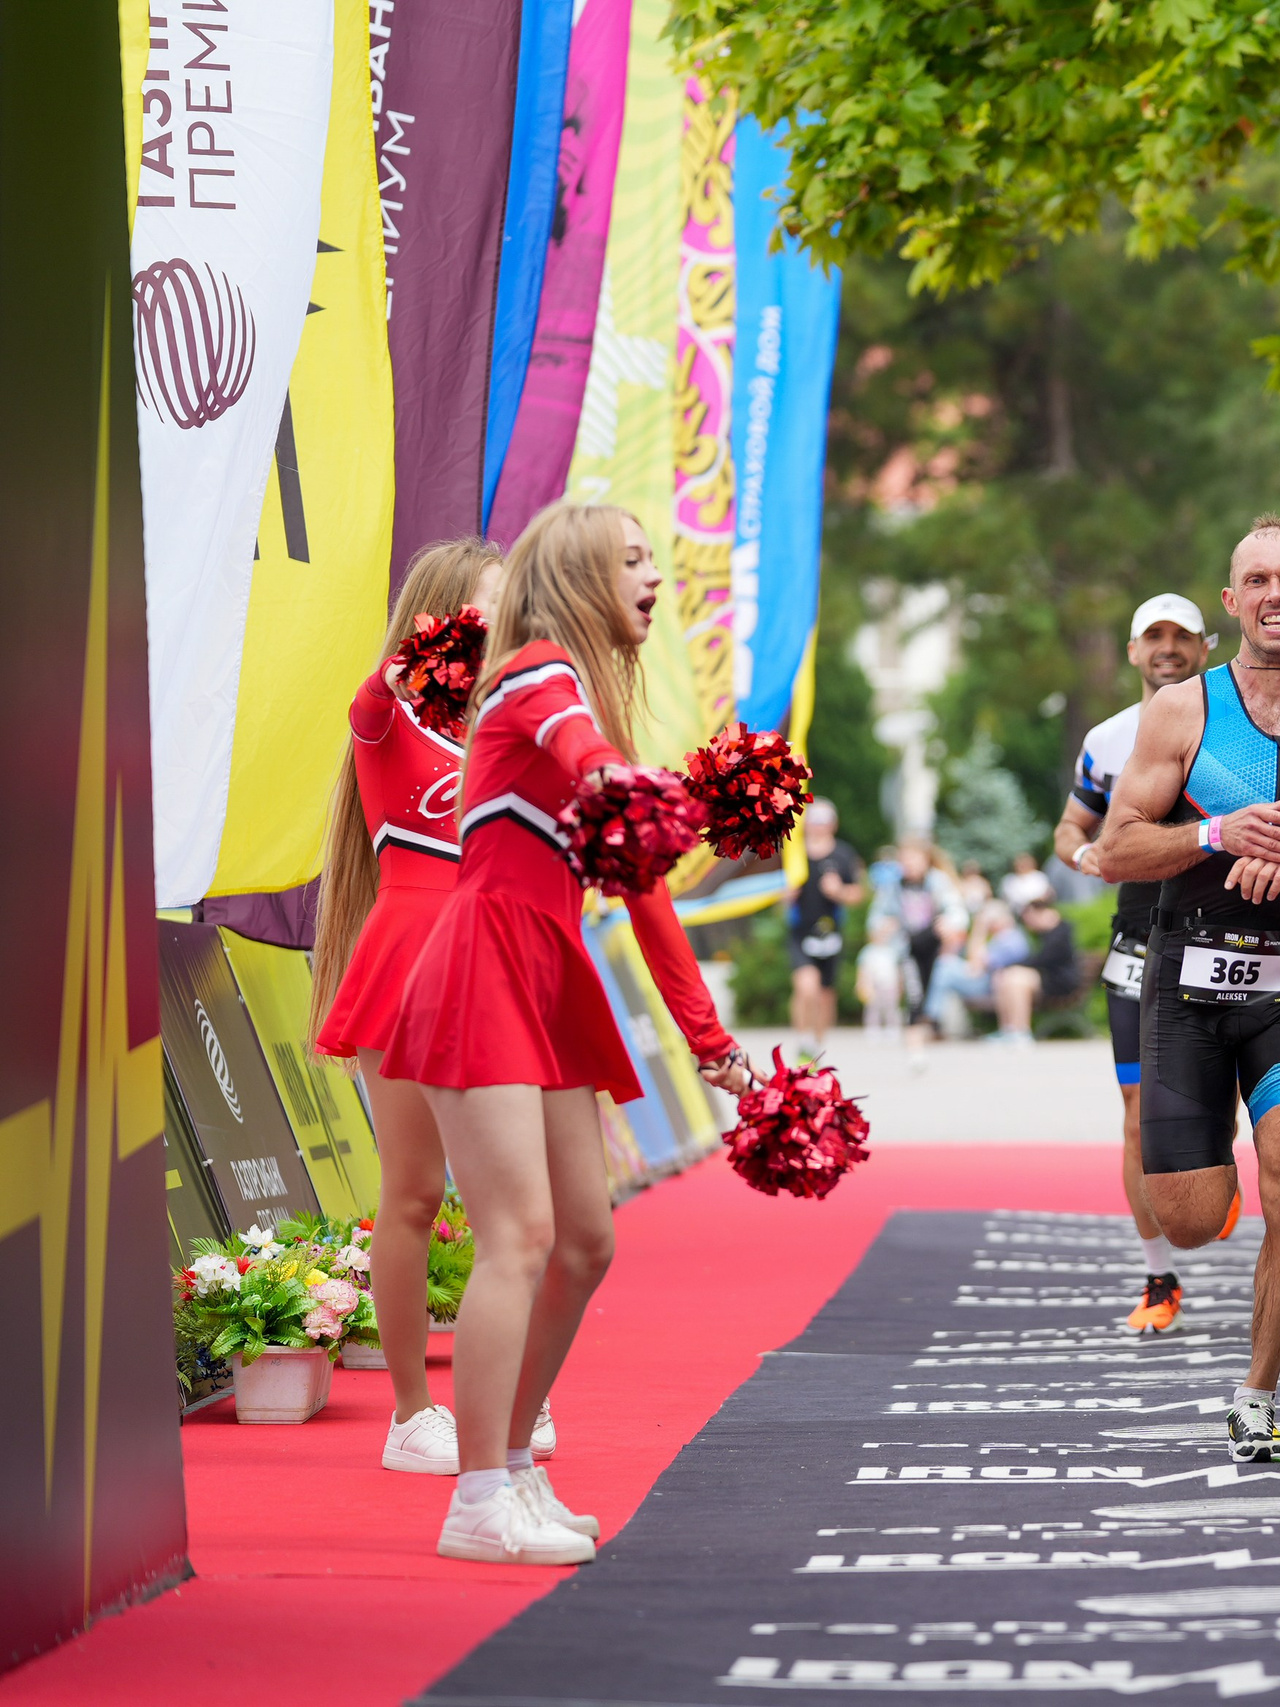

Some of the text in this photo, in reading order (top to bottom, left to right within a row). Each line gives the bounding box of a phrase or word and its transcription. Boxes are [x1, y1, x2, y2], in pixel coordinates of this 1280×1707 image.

[182, 0, 236, 210] ПРЕМ
[1224, 932, 1240, 941] IRON
[1244, 935, 1260, 944] STAR
[1209, 956, 1262, 986] 365
[1216, 992, 1249, 1001] ALEKSEY
[889, 1397, 1142, 1412] IRON
[856, 1466, 1145, 1480] IRON
[806, 1551, 1141, 1568] IRON
[727, 1656, 1134, 1682] IRON
